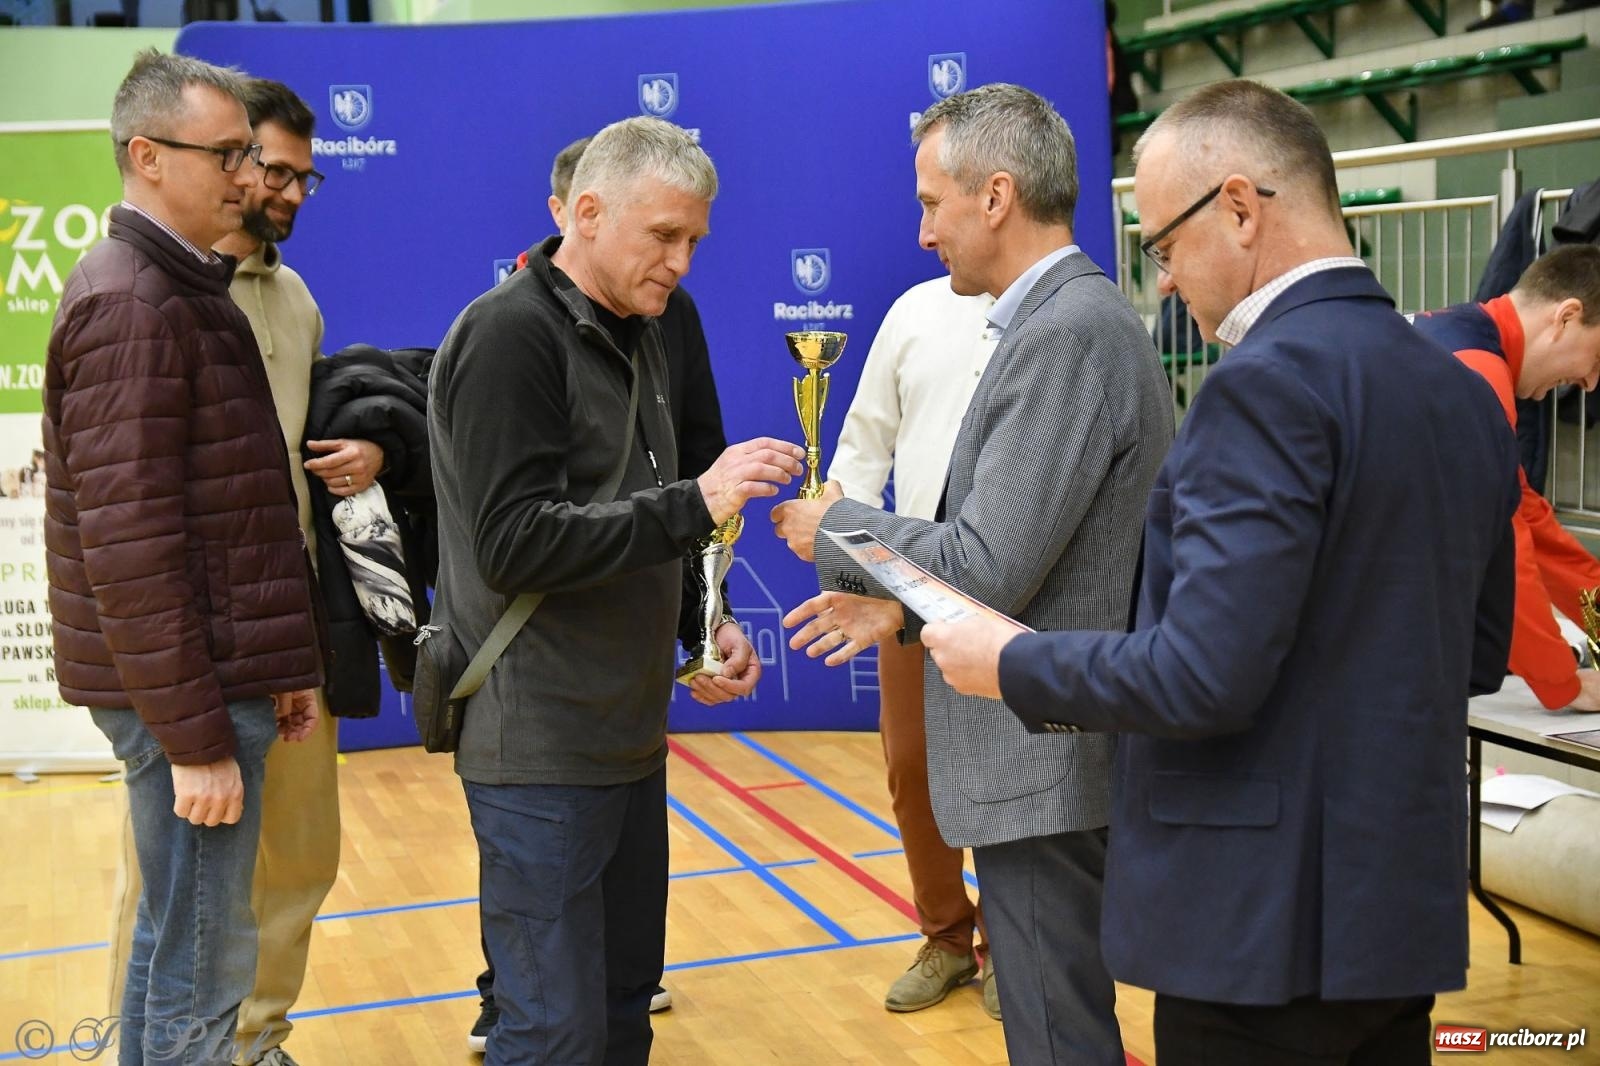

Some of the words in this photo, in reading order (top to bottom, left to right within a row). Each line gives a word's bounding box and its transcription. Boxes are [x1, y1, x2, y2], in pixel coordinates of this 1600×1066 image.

[311, 135, 397, 156] Racibórz
[11, 203, 111, 249] ZO
[8, 296, 49, 314] sklep
[773, 300, 854, 321] Racibórz
[1, 562, 49, 582] PR
[0, 600, 35, 615] UGA
